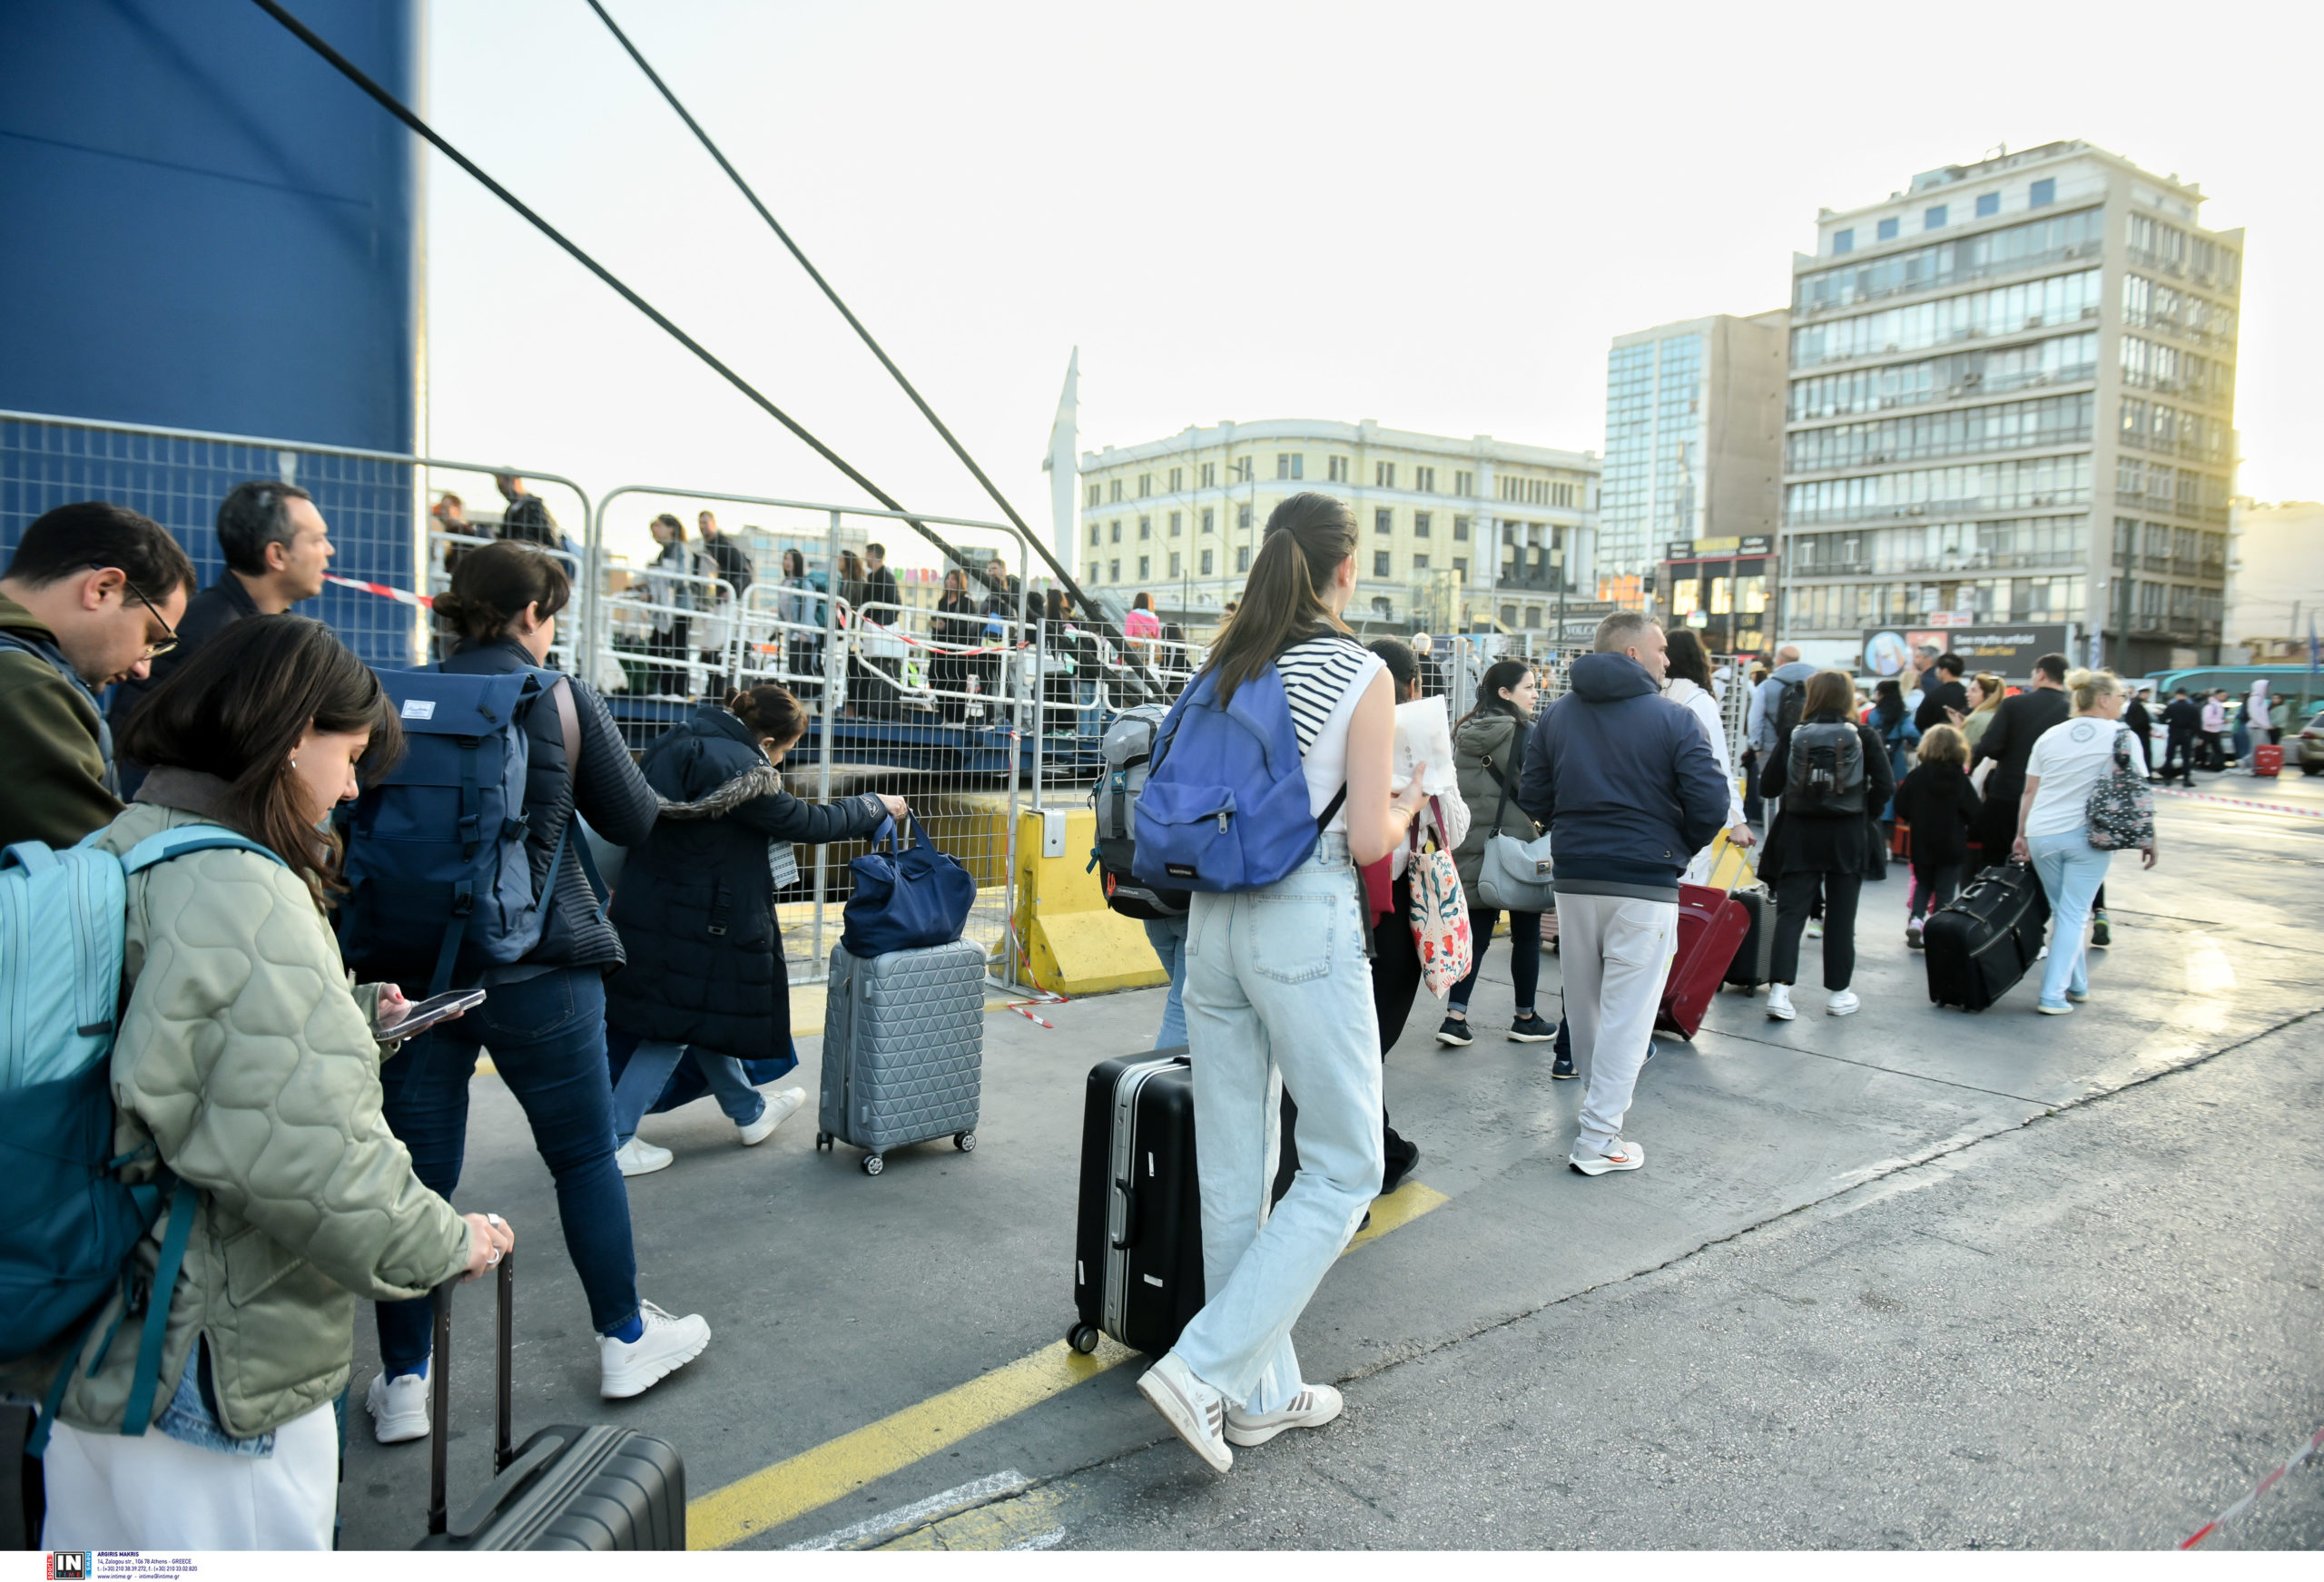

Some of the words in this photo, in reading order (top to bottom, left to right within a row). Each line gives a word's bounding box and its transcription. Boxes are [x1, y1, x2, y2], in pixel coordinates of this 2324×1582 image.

[1953, 634, 1974, 644] See
[1974, 634, 2004, 647] myths
[2004, 634, 2035, 644] unfold
[1952, 645, 1974, 656] with
